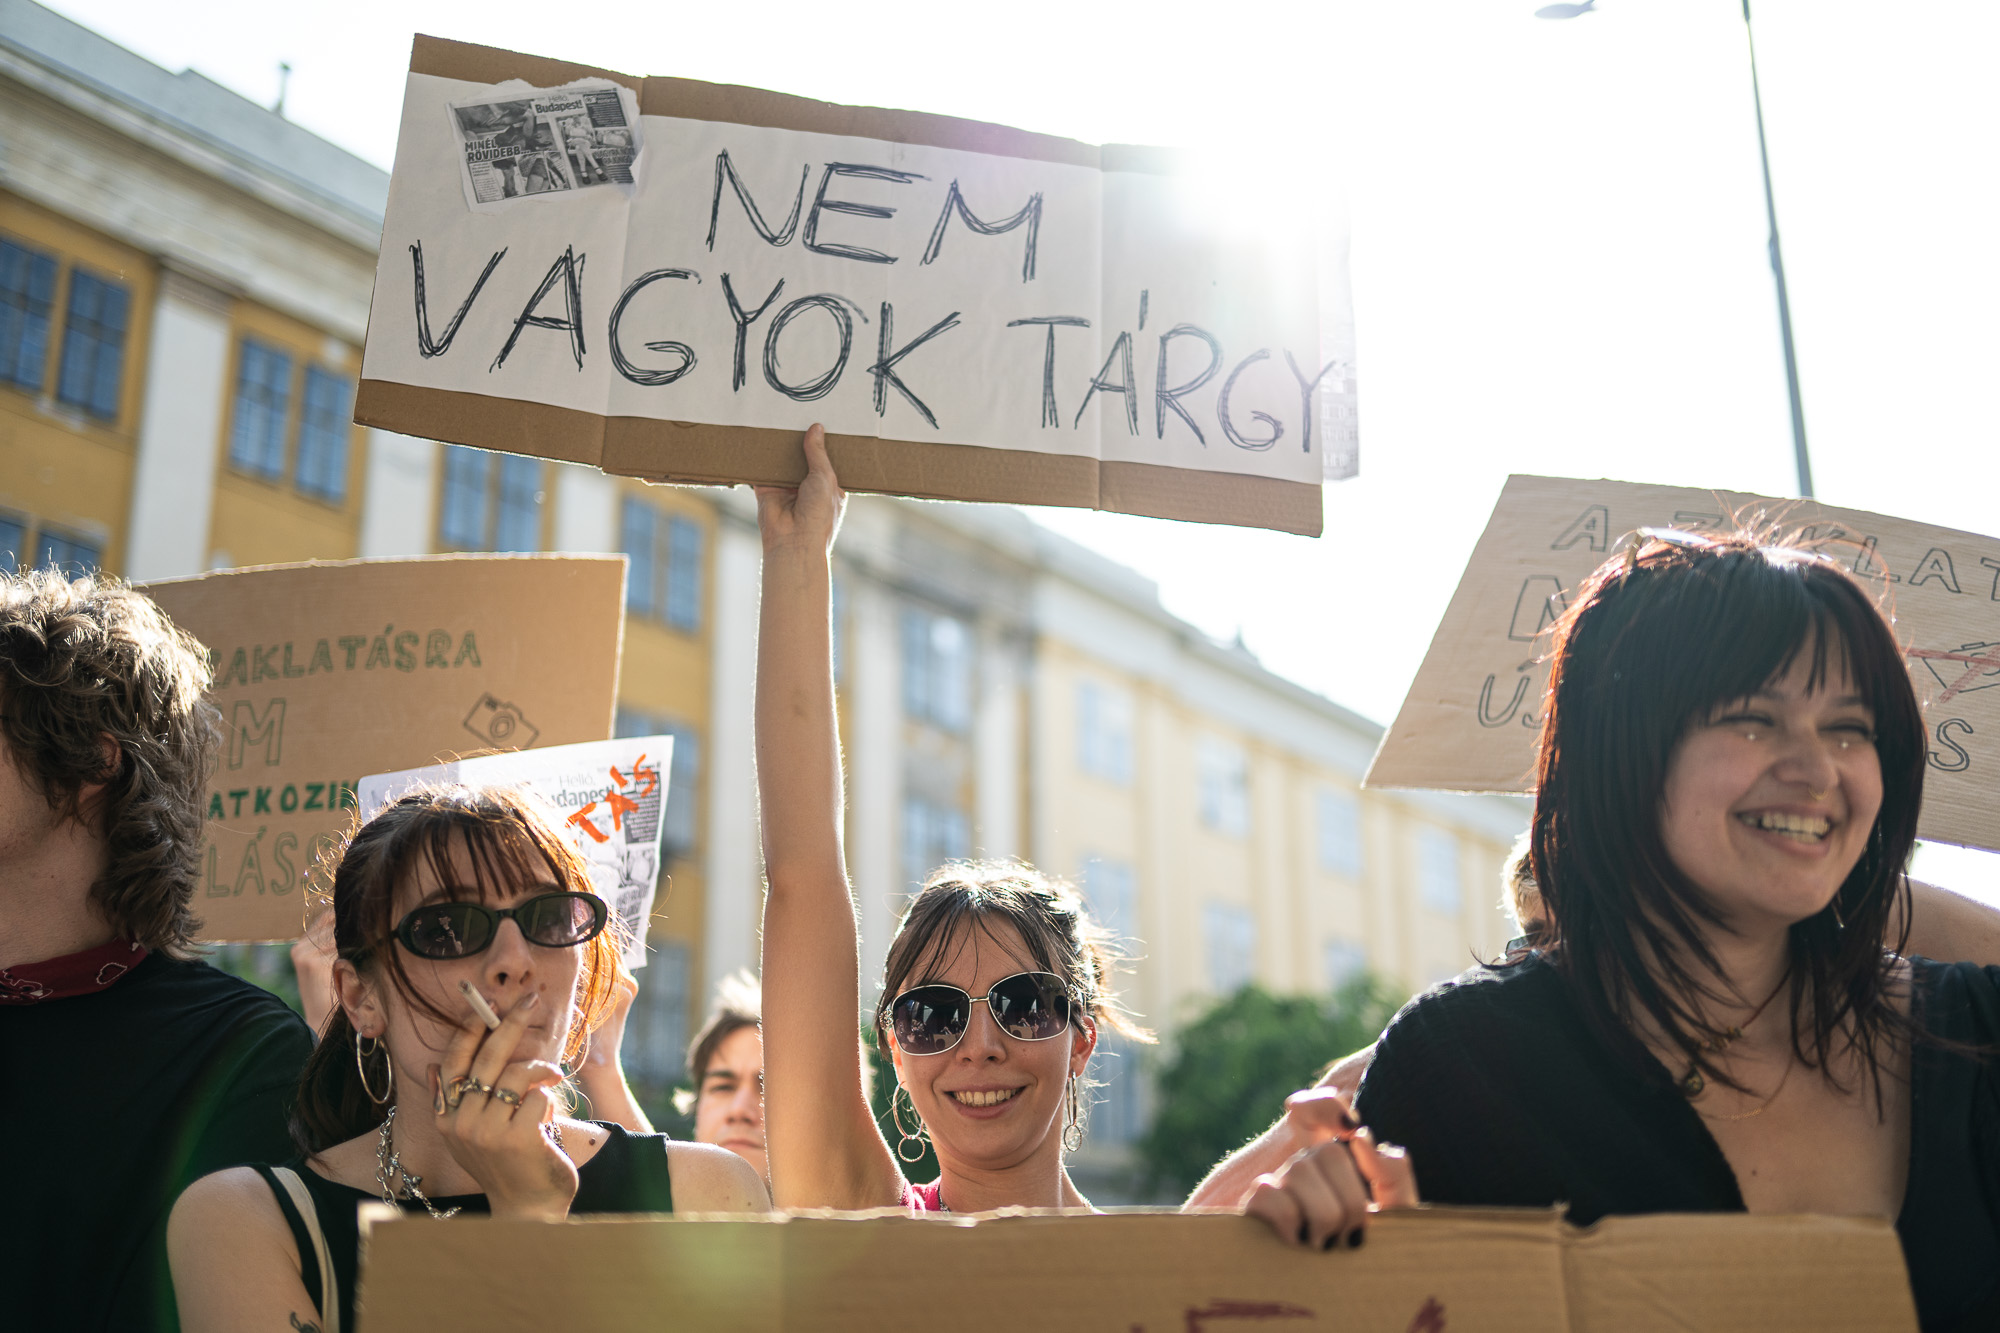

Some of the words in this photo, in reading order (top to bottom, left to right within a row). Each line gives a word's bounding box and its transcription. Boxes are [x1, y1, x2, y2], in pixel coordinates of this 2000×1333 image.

[535, 99, 583, 114] Budapest!
[465, 138, 497, 152] MINÉL
[706, 148, 1043, 283] NEM
[409, 240, 960, 430] VAGYOK
[1007, 290, 1336, 453] TÁRGY
